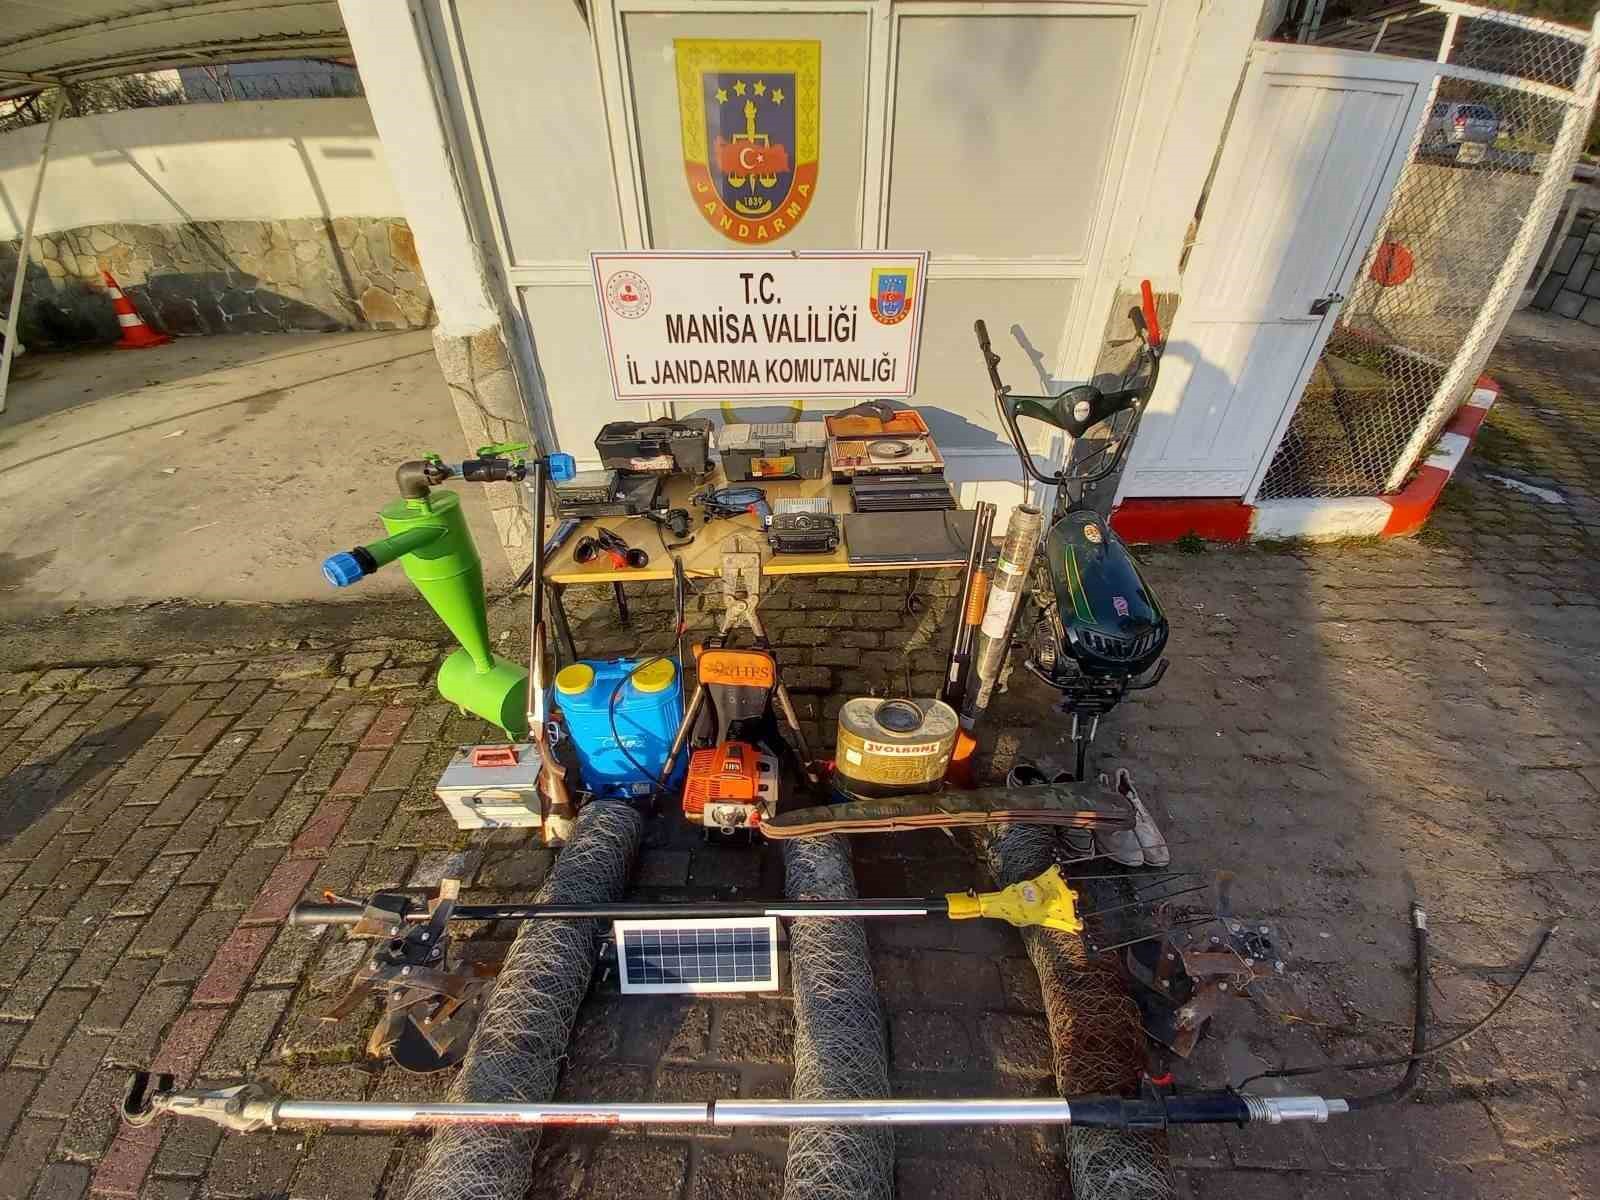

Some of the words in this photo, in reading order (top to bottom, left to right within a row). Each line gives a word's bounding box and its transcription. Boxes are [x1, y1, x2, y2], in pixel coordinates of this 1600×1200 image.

[696, 183, 810, 239] JANDARMA
[739, 272, 782, 304] T.C.
[665, 305, 758, 344] MANİSA
[763, 304, 858, 343] VALİLİĞİ
[626, 354, 646, 385] İL
[651, 358, 761, 385] JANDARMA
[765, 352, 897, 384] KOMUTANLIĞI
